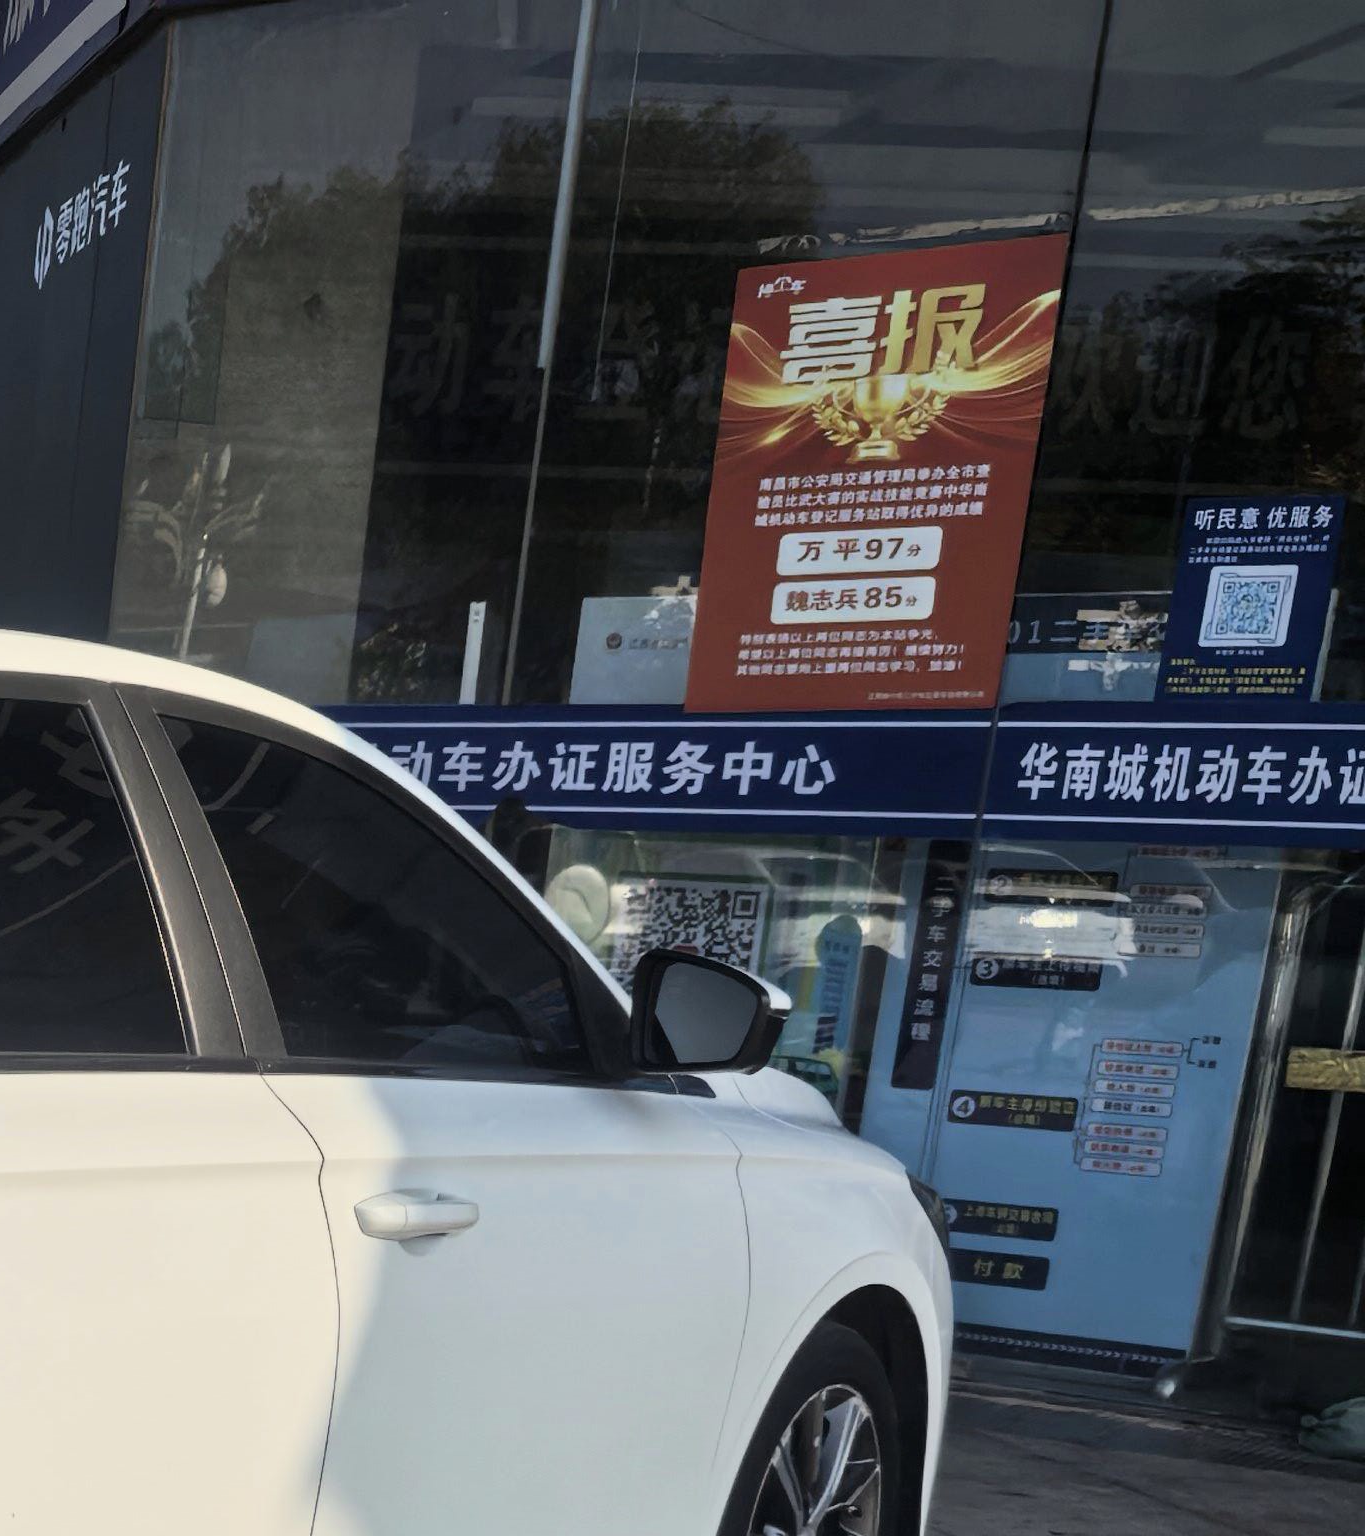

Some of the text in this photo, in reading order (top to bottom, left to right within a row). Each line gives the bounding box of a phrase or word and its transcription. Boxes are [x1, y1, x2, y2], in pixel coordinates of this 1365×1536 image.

[56, 160, 131, 264] 零跑汽车
[780, 284, 986, 385] 喜报
[1194, 505, 1334, 530] 听民意 优服务
[373, 740, 836, 796] 动车办证服务中心
[1017, 742, 1365, 806] 华南城机动车办证
[973, 1258, 1025, 1280] 付款
